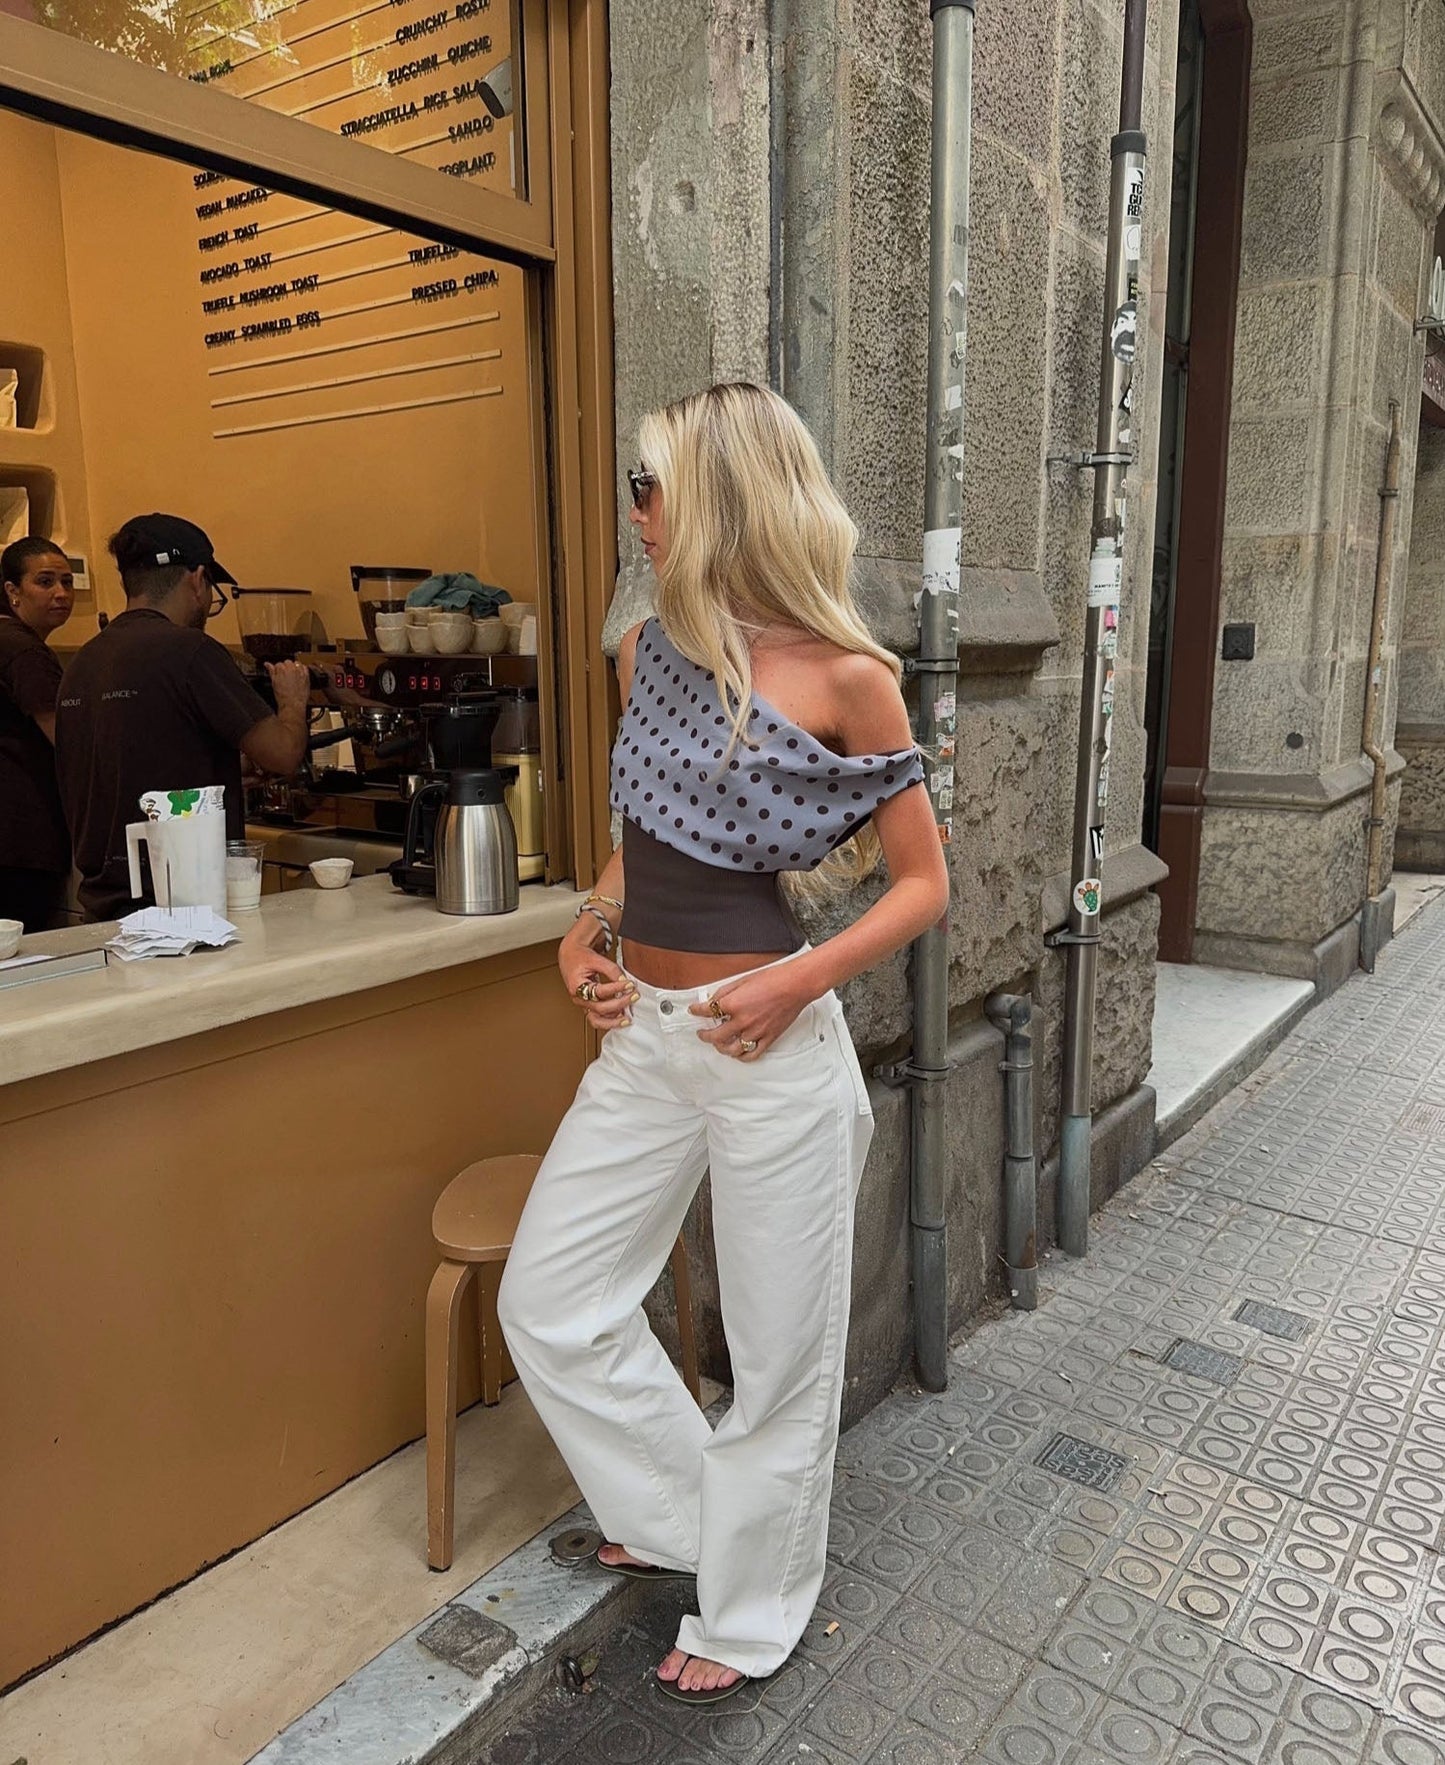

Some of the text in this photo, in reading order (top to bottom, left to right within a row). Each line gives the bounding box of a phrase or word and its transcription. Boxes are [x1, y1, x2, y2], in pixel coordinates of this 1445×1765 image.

[395, 10, 448, 41] CRUNCHY
[387, 36, 490, 83] ZUCCHINI QUICHE
[340, 77, 483, 136] STRACCIATELLA RICE SALA
[448, 115, 492, 138] SANDO
[195, 187, 267, 218] VEGAN PANCAKES
[198, 222, 258, 250] FRENCH TOAST
[200, 252, 272, 282] AVOCADO TOAST
[202, 274, 319, 313] TRUFFLE MUSHROOM TOAST
[411, 269, 497, 300] PRESSED CHIPA
[204, 311, 320, 345] CREAMY SCRAMBLED EGGS
[61, 698, 81, 707] ABOUT
